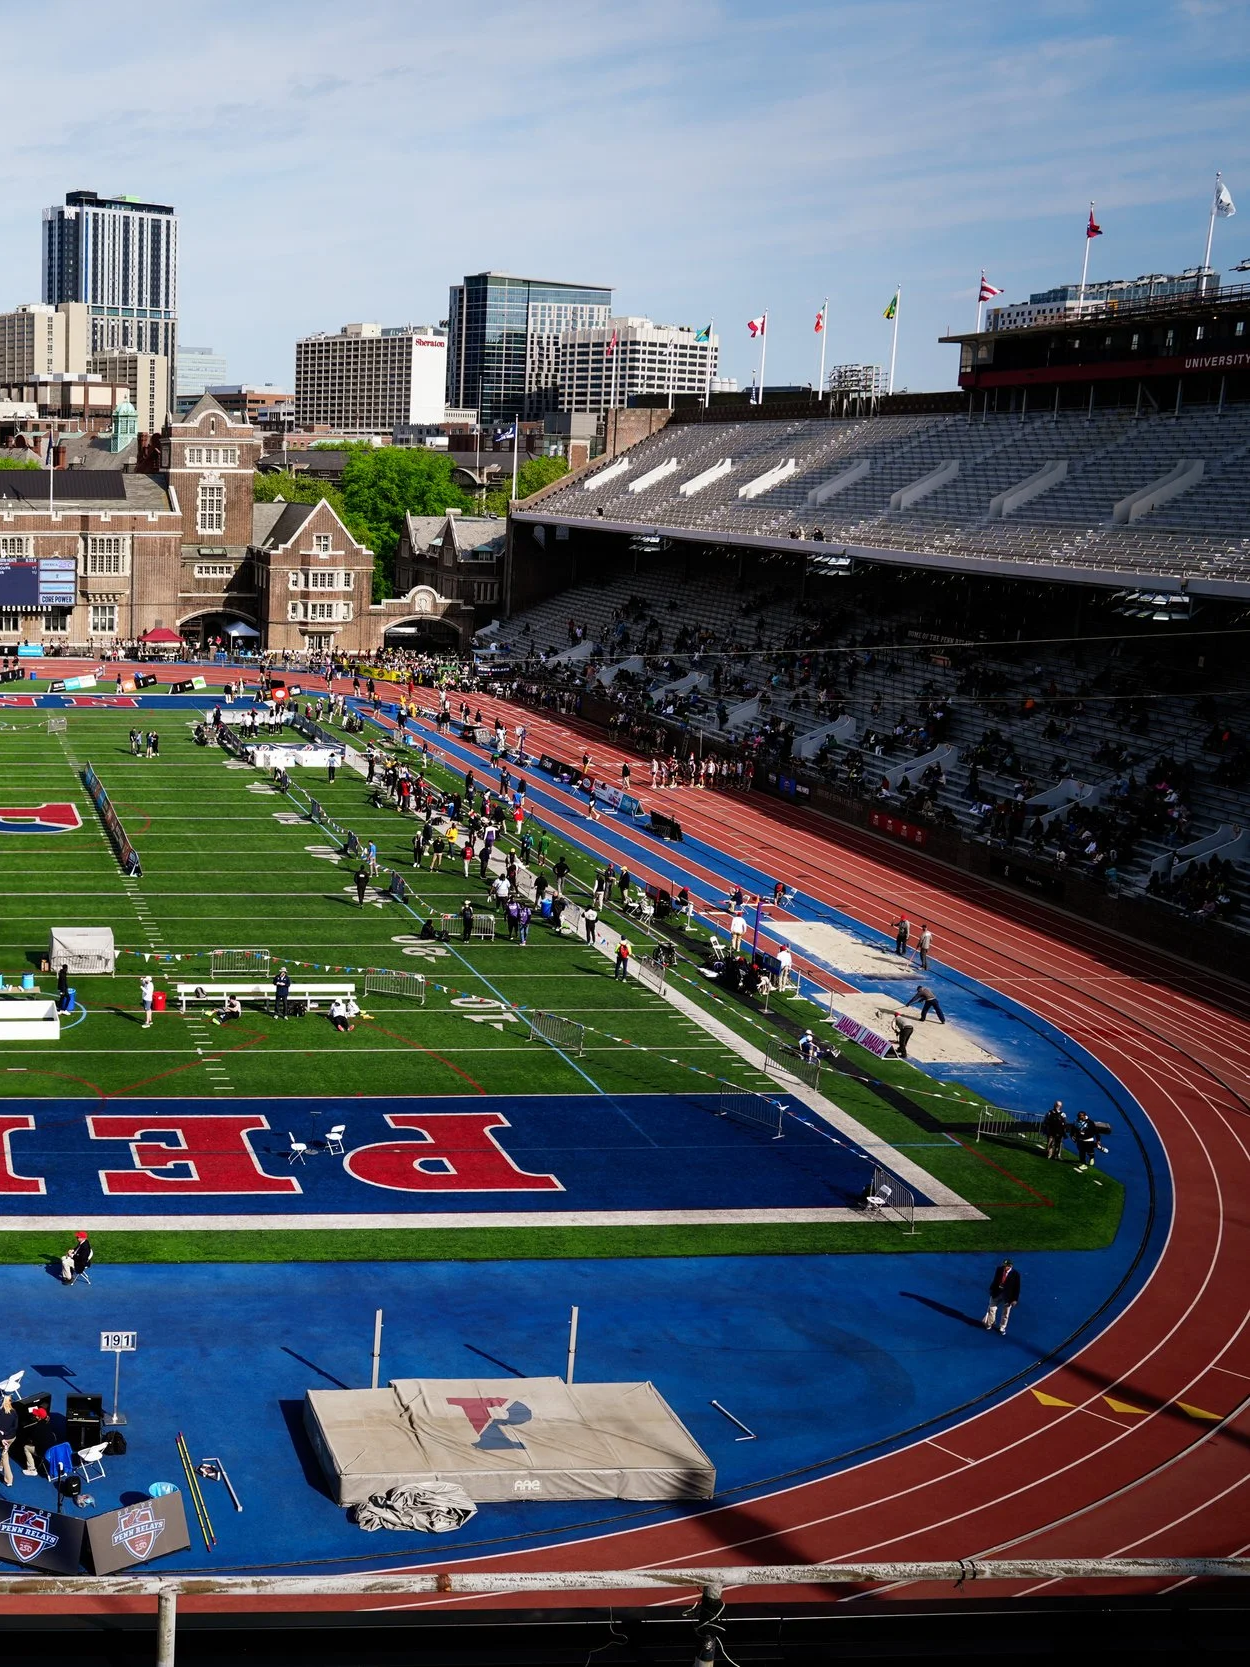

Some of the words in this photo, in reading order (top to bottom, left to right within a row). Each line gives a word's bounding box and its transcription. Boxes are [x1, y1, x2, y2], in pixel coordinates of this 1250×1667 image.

[415, 338, 445, 348] Sheraton
[1185, 354, 1250, 369] UNIVERSITY
[390, 935, 451, 956] 20
[450, 997, 520, 1023] 10
[834, 1015, 862, 1040] JAMAICA
[859, 1031, 888, 1057] JAMAICA
[103, 1334, 131, 1347] 191
[0, 1524, 24, 1536] PENN
[24, 1528, 57, 1544] RELAYS
[113, 1529, 135, 1543] PENN
[134, 1521, 164, 1535] RELAYS
[18, 1543, 33, 1553] 250
[134, 1541, 148, 1552] 250
